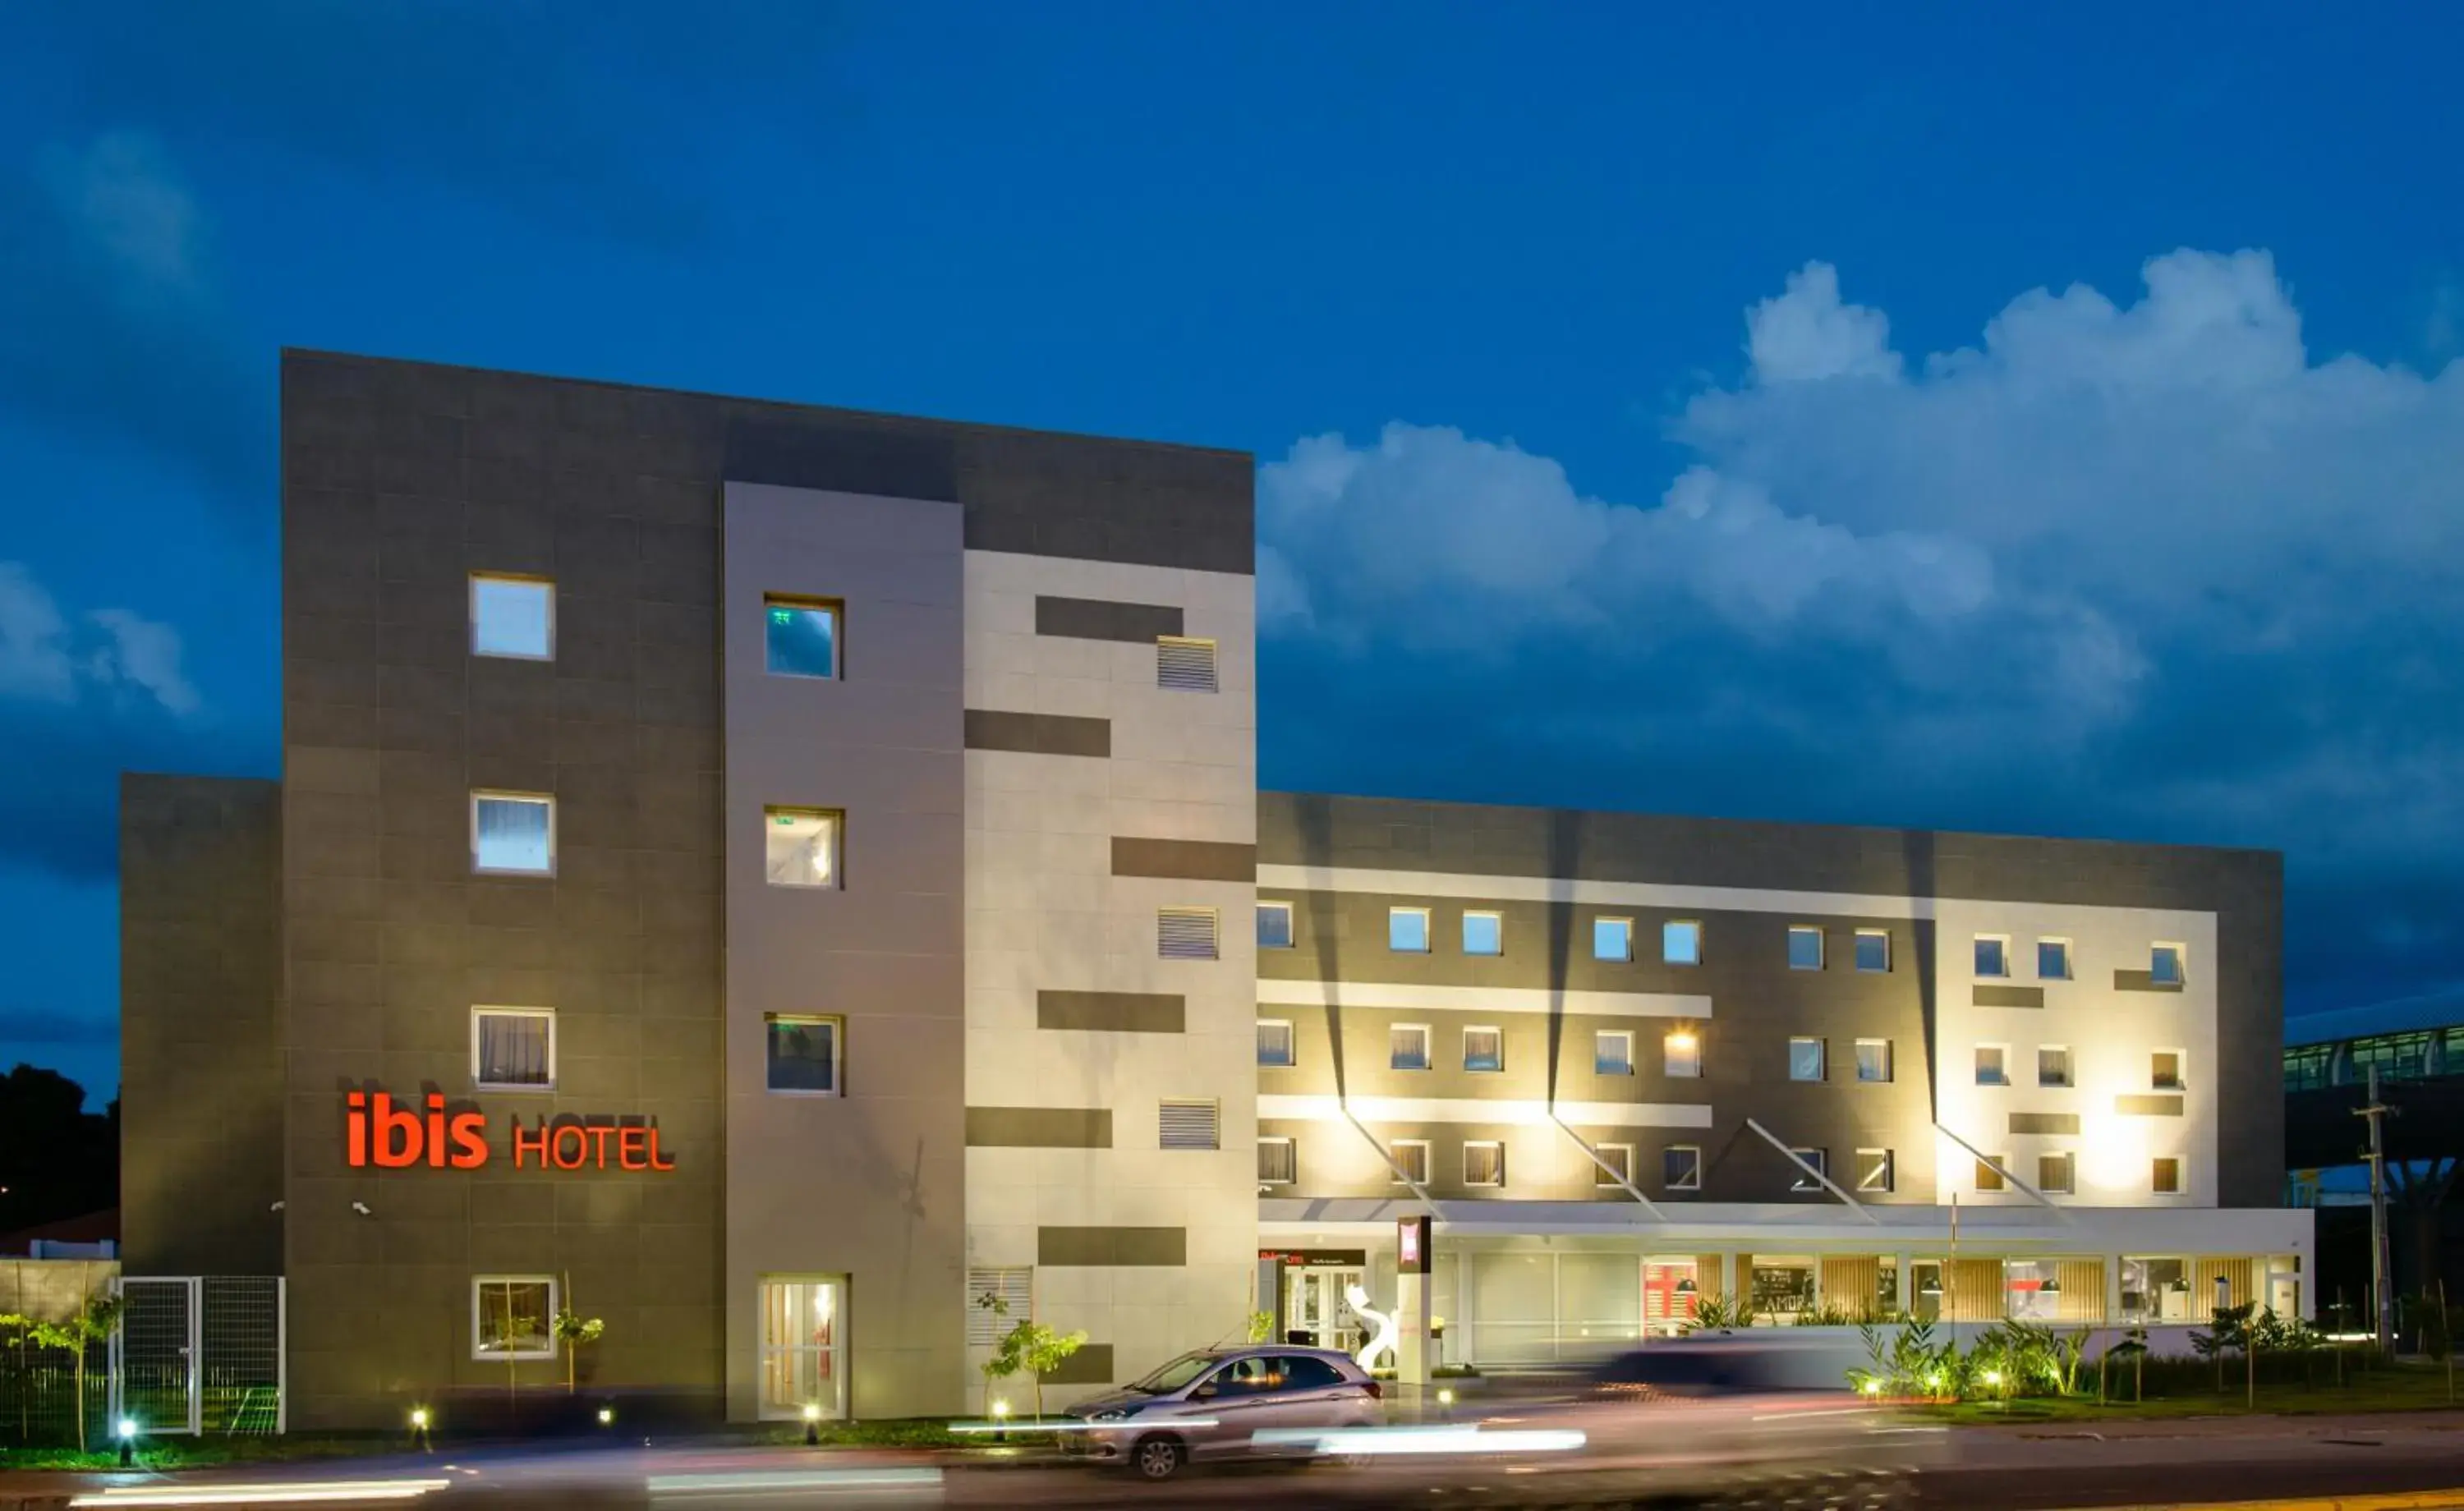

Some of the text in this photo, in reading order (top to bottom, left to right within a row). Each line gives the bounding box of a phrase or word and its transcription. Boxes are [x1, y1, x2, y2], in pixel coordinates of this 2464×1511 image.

[347, 1091, 674, 1171] ibis HOTEL
[1765, 1294, 1804, 1311] AMOR
